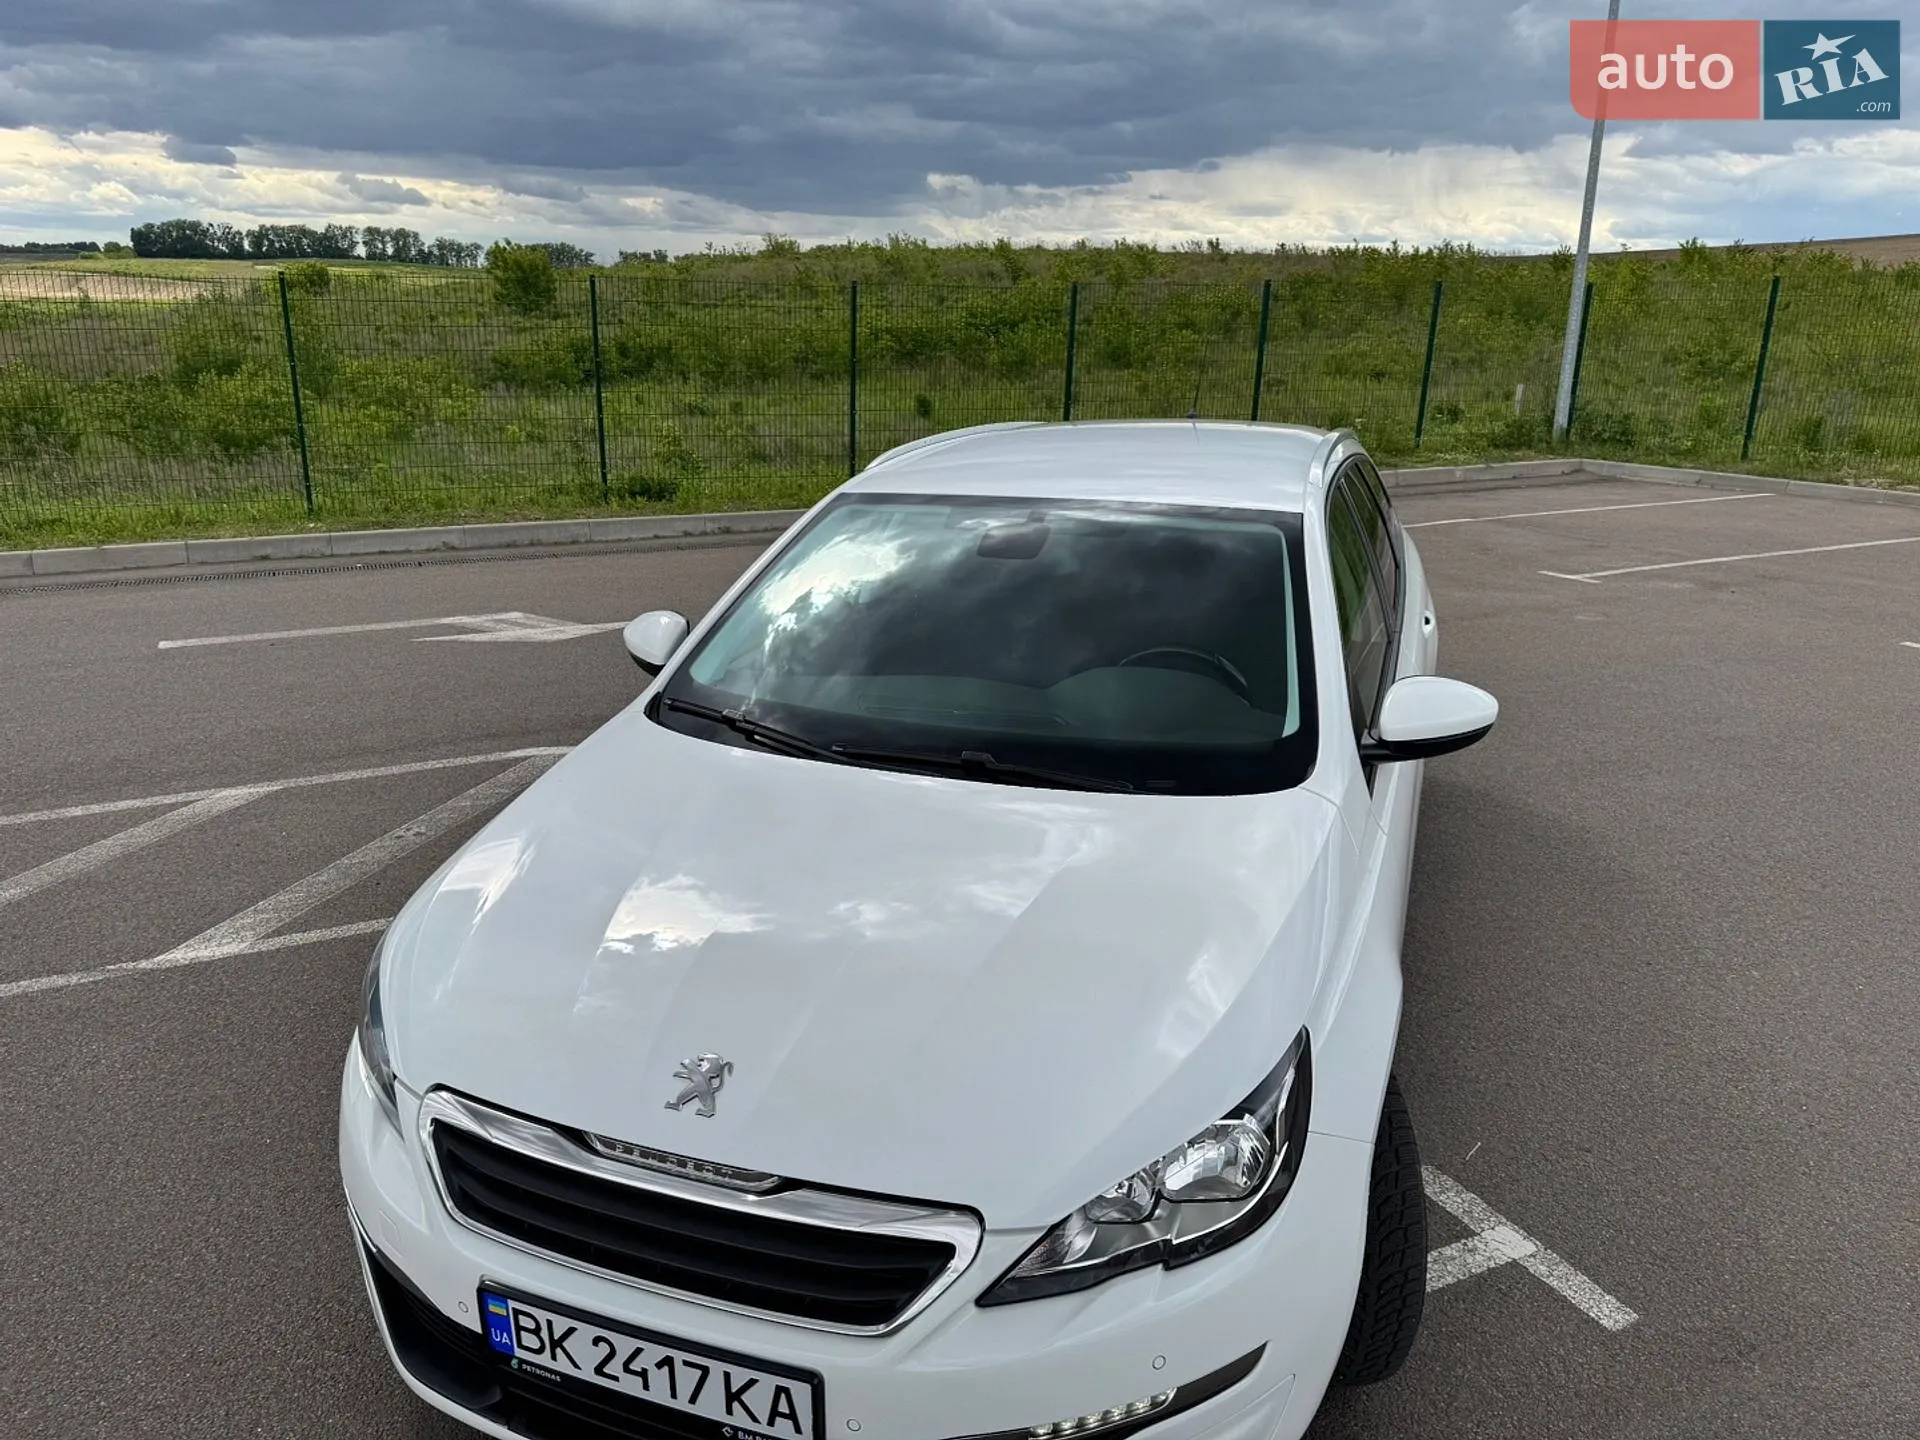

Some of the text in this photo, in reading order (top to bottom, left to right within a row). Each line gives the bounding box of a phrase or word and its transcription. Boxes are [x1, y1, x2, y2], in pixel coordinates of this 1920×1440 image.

[491, 1327, 512, 1347] UA
[512, 1307, 803, 1435] BK 2417 KA
[521, 1363, 562, 1383] PETRONAS
